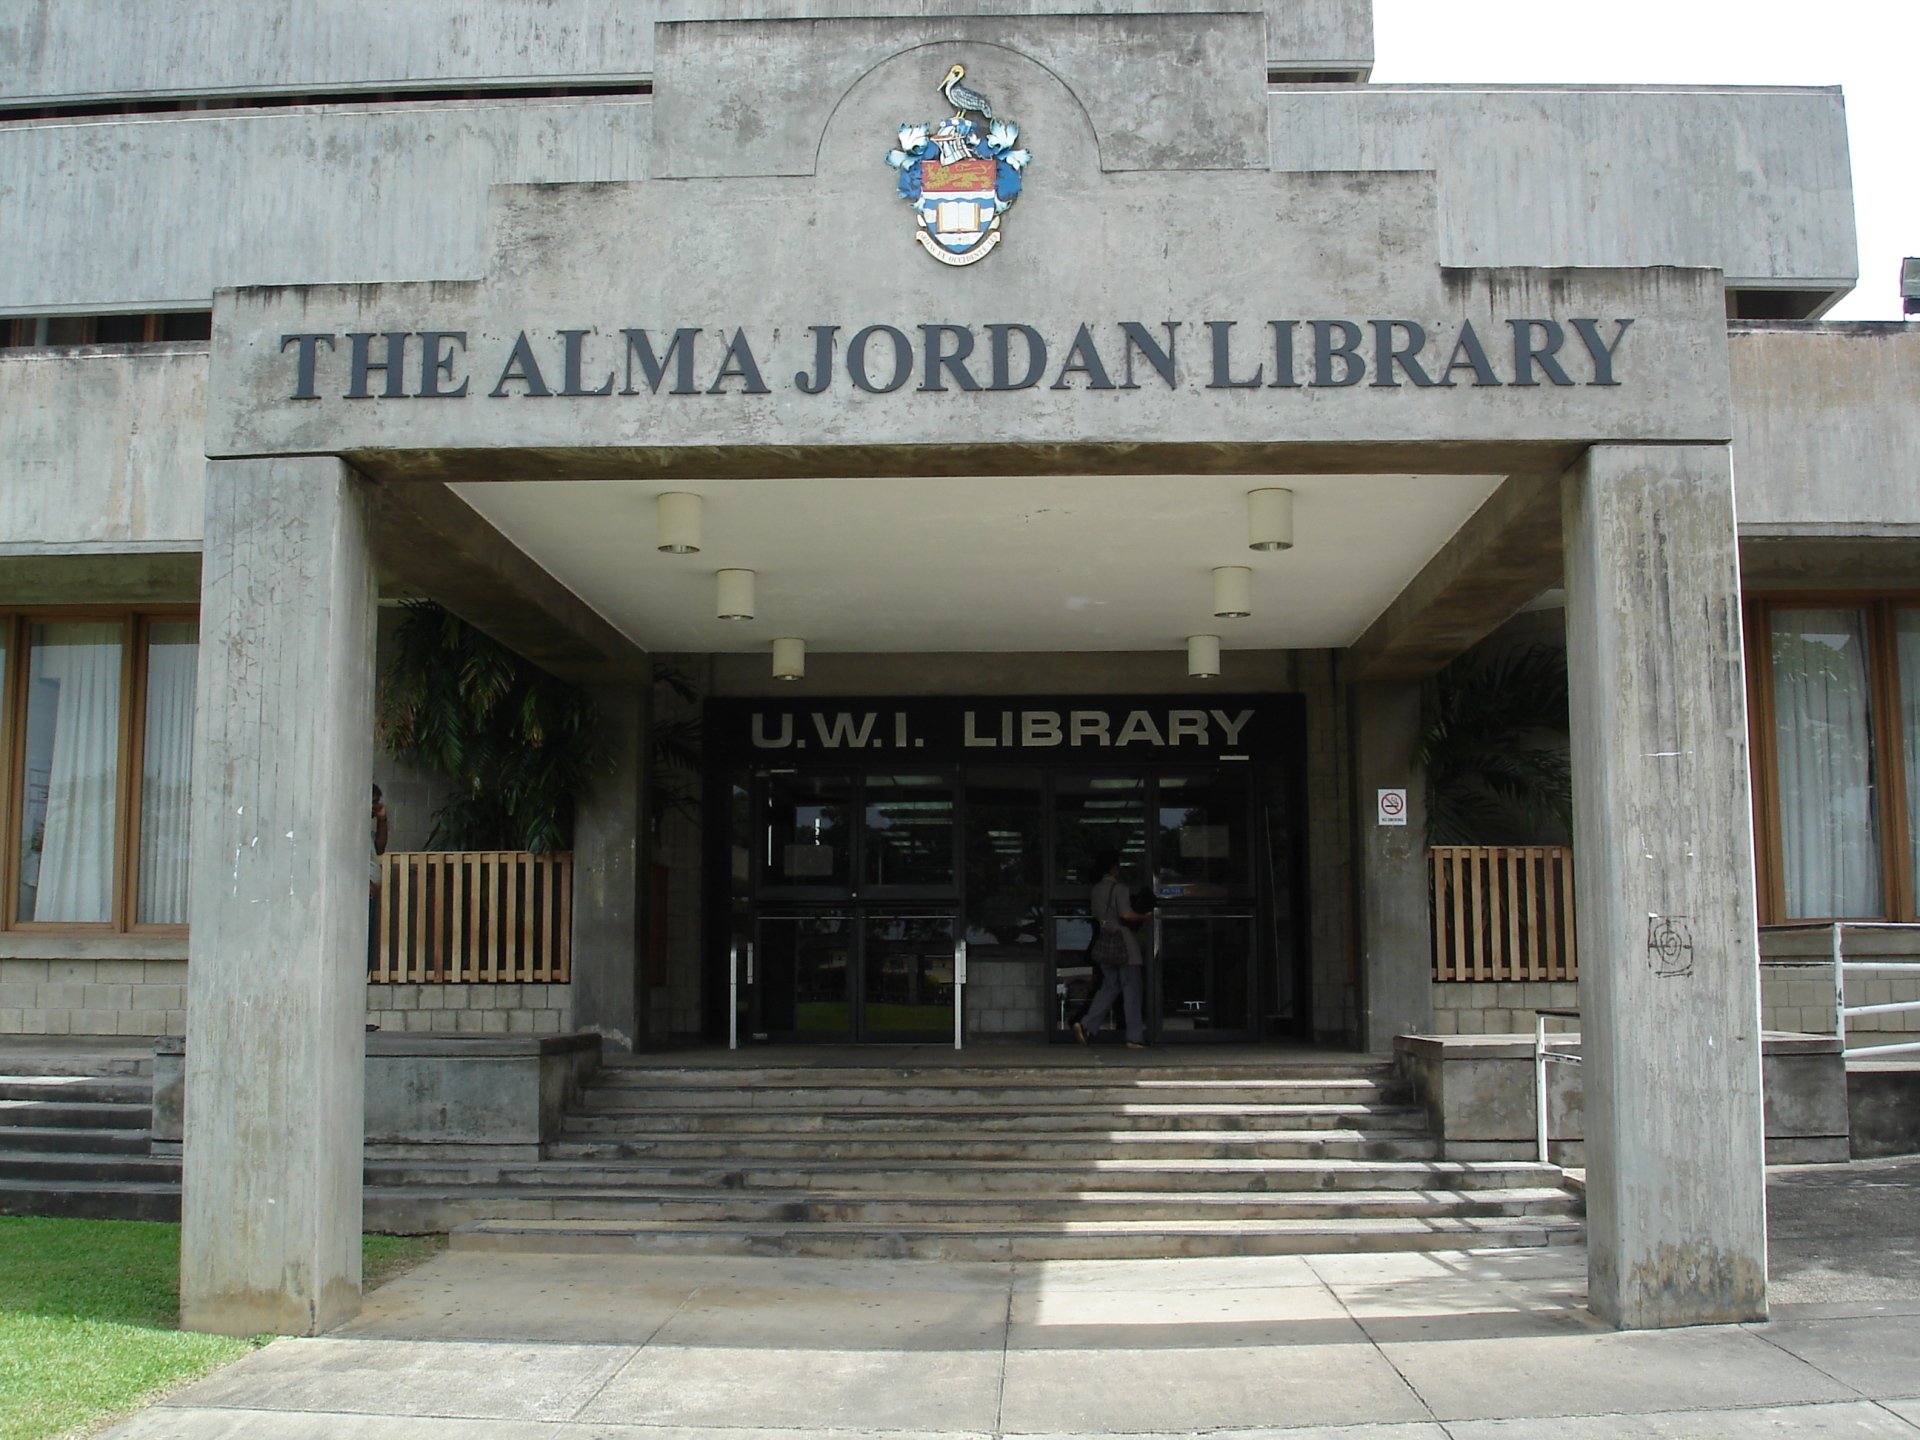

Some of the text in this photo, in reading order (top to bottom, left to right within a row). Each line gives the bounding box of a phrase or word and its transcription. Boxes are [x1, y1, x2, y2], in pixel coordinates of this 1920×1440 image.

[281, 318, 1634, 400] THE ALMA JORDAN LIBRARY
[751, 710, 1255, 748] U.W.I. LIBRARY
